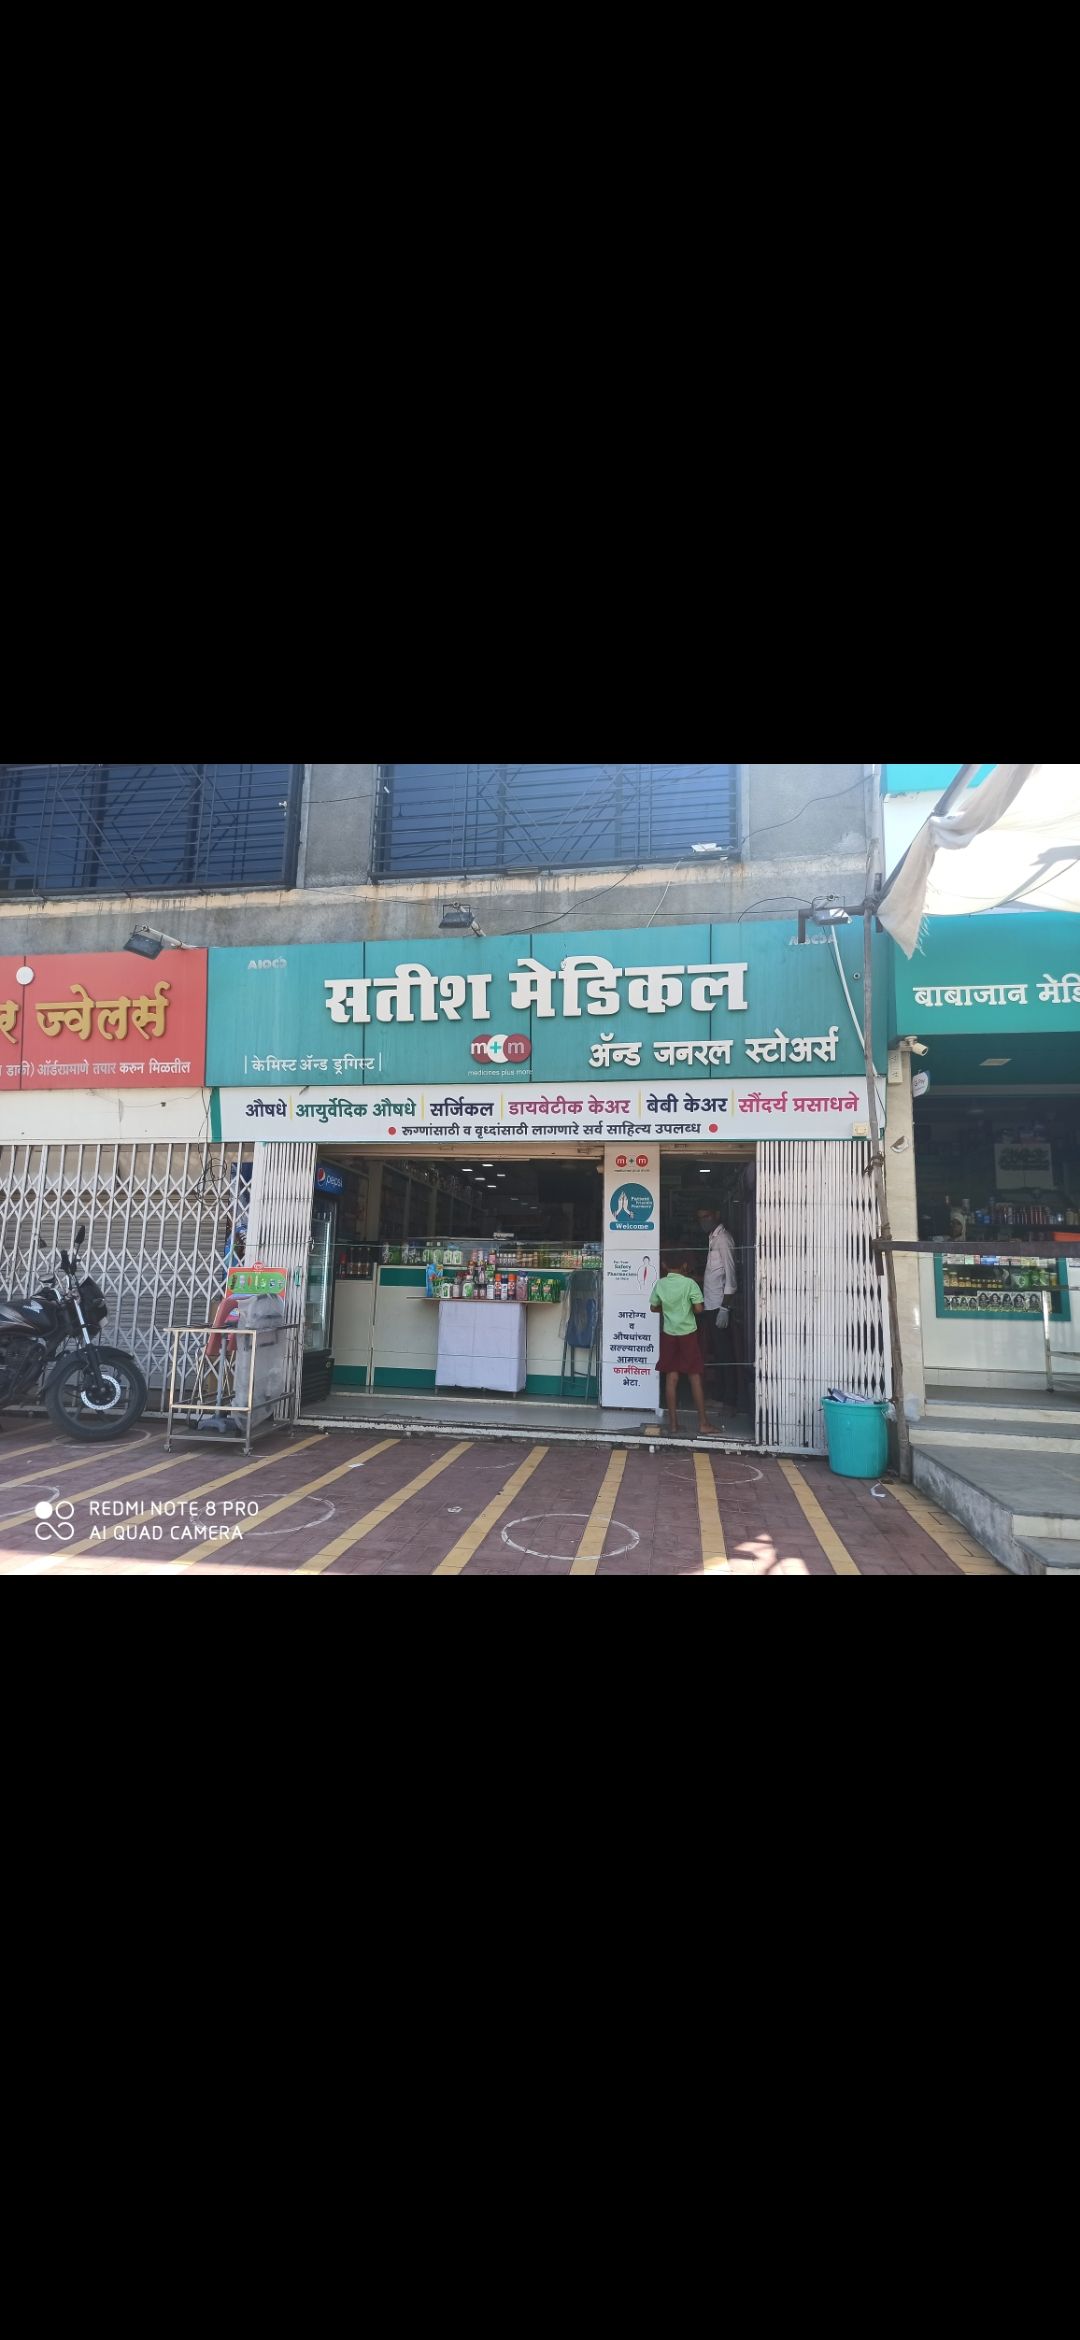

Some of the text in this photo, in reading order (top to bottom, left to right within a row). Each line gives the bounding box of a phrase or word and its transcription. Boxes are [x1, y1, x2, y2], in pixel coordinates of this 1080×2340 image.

[324, 955, 748, 1024] सतीश मेडिकल
[912, 983, 1029, 1007] बाबाजान
[35, 980, 172, 1041] ज्वेलर्स
[653, 1039, 734, 1066] जनरल
[745, 1025, 839, 1063] स्टोअर्स
[149, 1057, 192, 1075] मिळतील
[251, 1055, 297, 1072] केमिस्ट
[501, 1069, 515, 1077] plus
[245, 1097, 417, 1123] औषधे आयुर्वेदिक औषधे
[429, 1096, 495, 1117] सर्जिकल
[508, 1094, 631, 1116] डायबेटीक केअर
[646, 1092, 729, 1113] बेबी केअर
[738, 1090, 860, 1113] सौंदर्य प्रसाधने
[463, 1125, 471, 1135] व
[531, 1120, 580, 1135] लागणारे
[583, 1120, 603, 1136] सर्व
[606, 1120, 651, 1136] साहित्य
[655, 1123, 701, 1134] उपलब्ध
[326, 1175, 343, 1187] pepsi
[618, 1309, 646, 1319] आरोग्य
[617, 1355, 648, 1364] आमच्या
